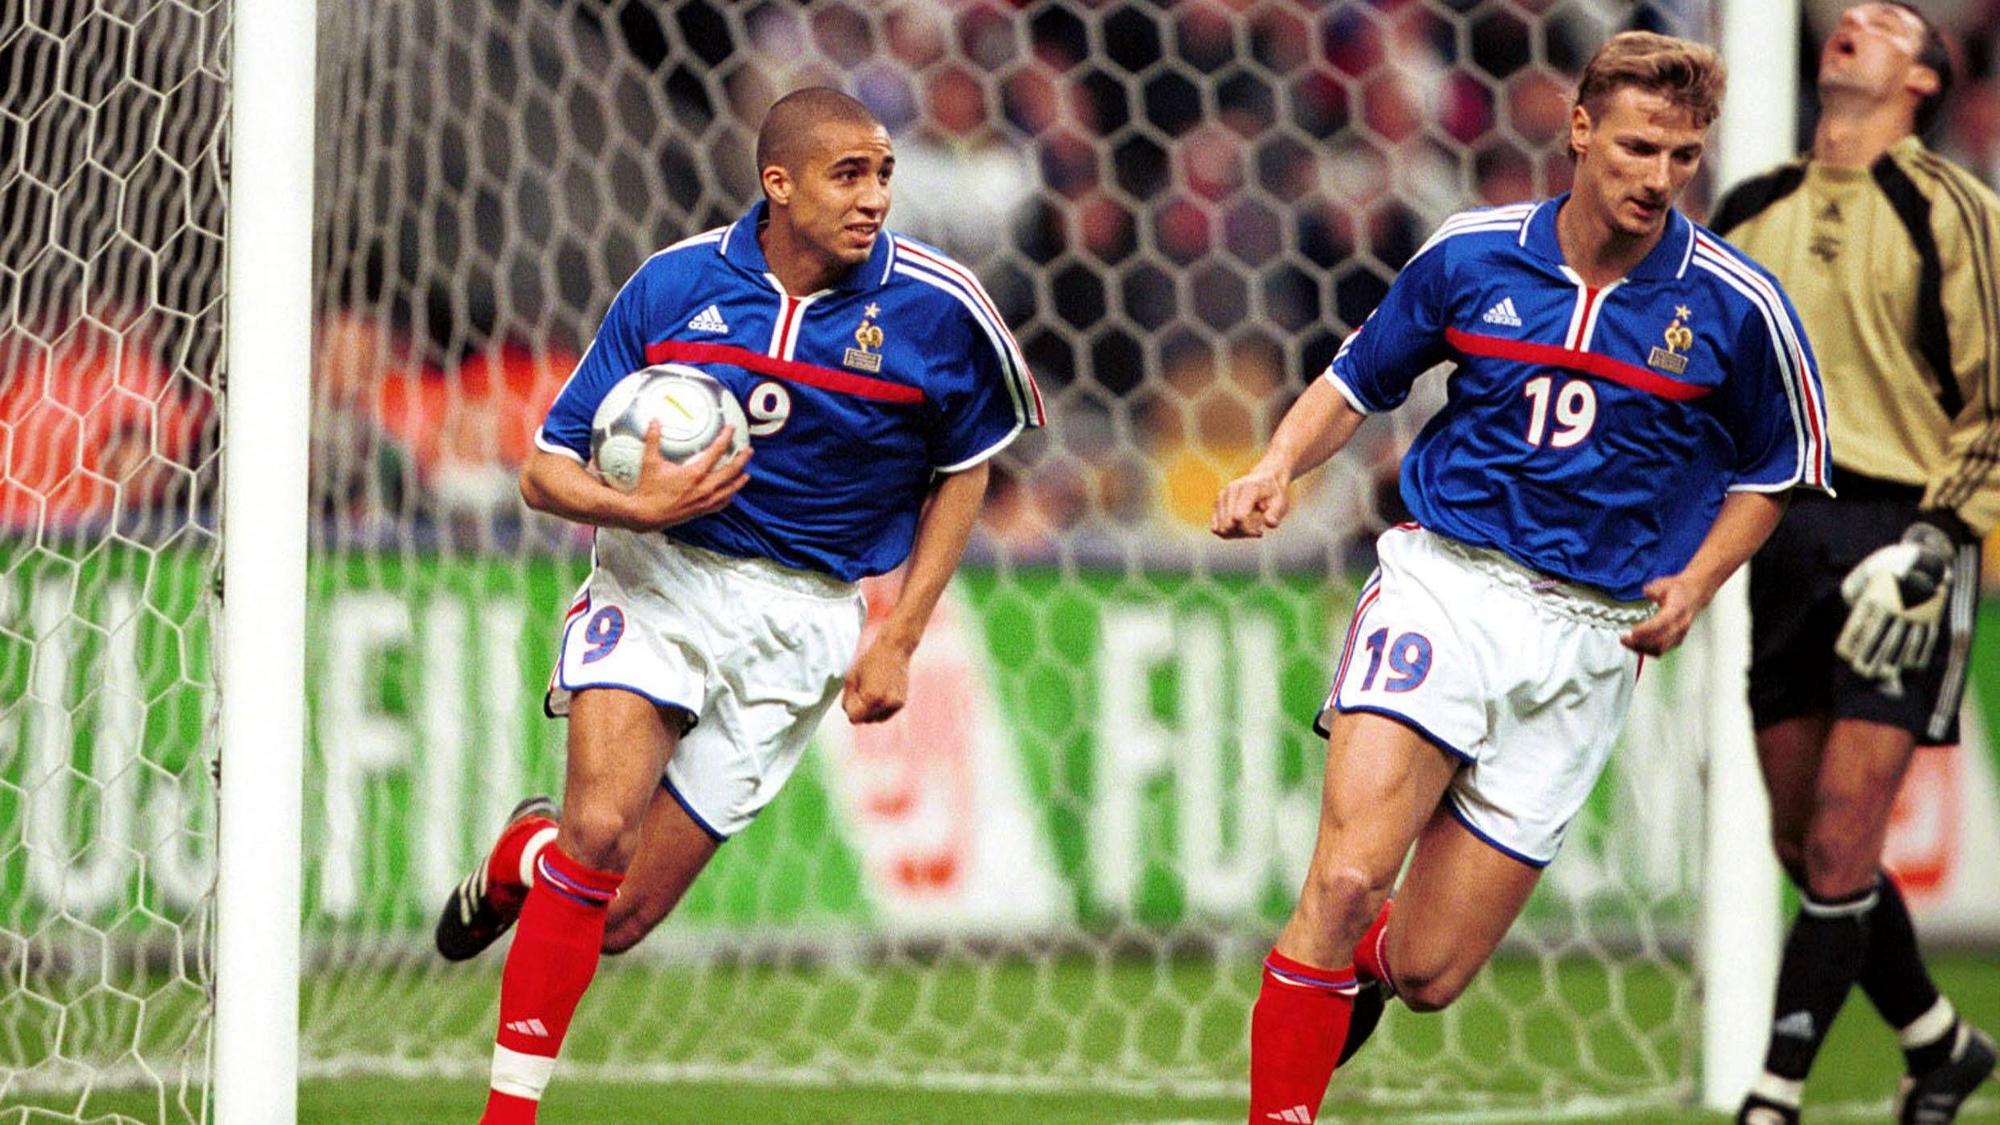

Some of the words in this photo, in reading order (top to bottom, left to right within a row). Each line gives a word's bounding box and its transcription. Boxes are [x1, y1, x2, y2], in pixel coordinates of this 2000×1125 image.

[688, 320, 729, 334] adidas
[748, 381, 791, 436] 9
[1524, 375, 1597, 448] 19
[582, 604, 626, 665] 9
[1360, 626, 1433, 694] 19
